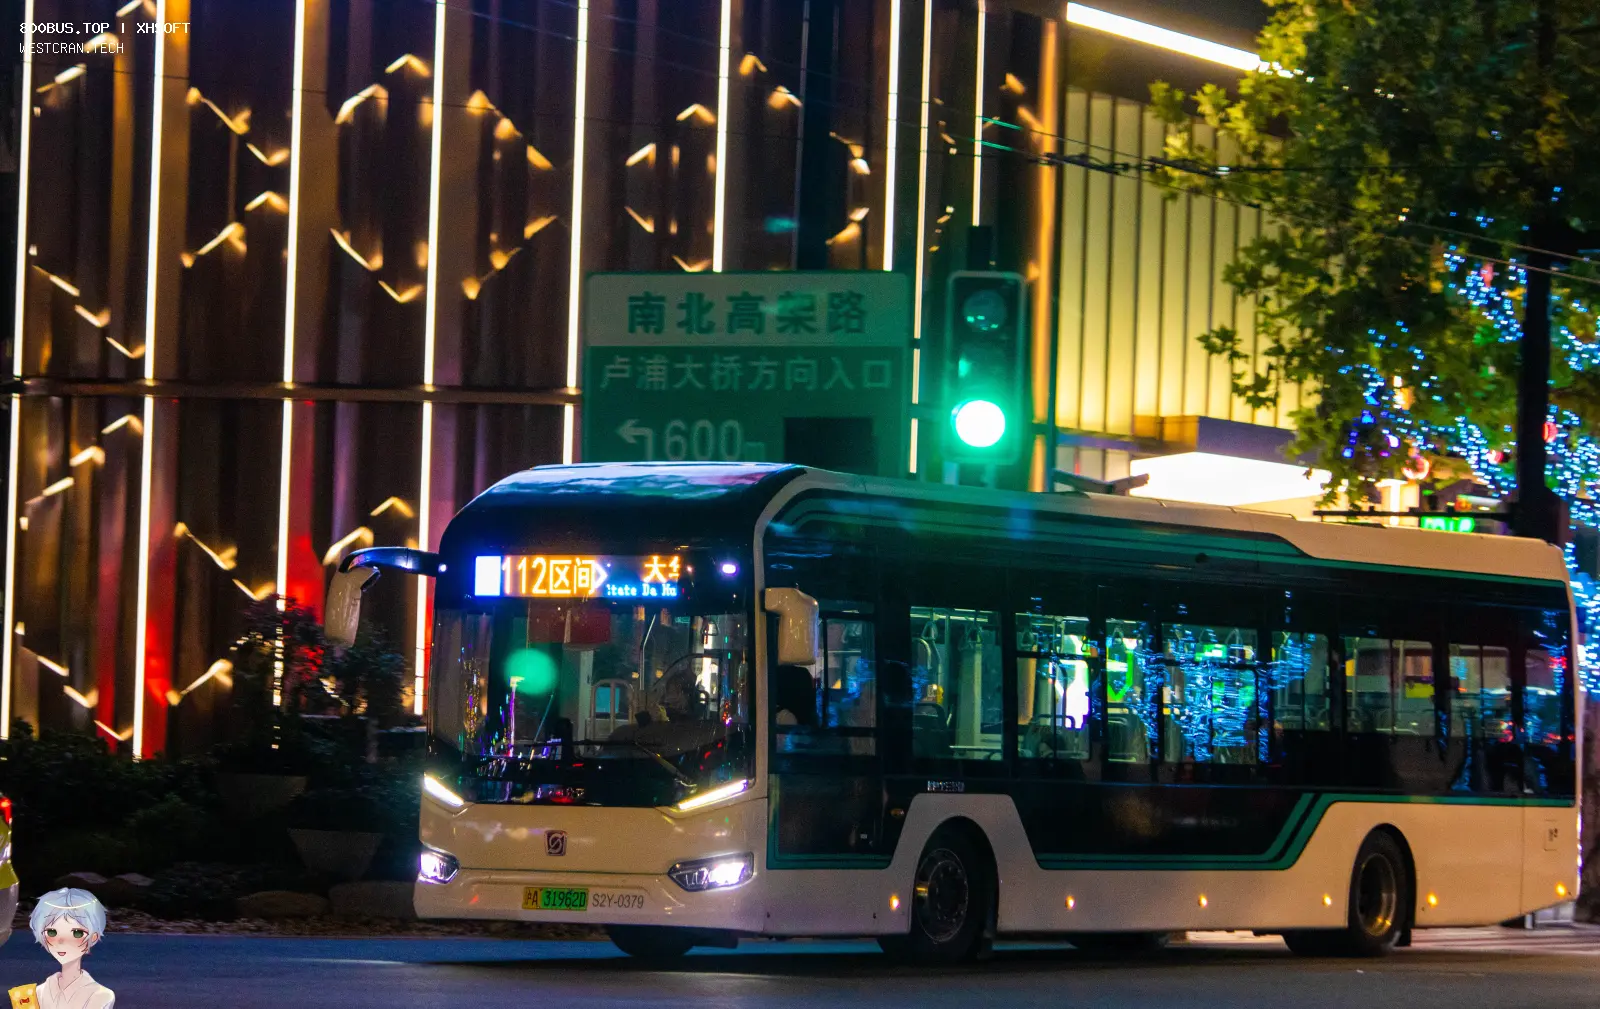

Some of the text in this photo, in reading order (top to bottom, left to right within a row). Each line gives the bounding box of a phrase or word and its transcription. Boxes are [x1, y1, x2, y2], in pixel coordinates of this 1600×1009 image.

[627, 291, 867, 335] 南北高架路
[600, 355, 892, 391] 卢浦大桥方向入口
[592, 894, 644, 909] S2Y-0379
